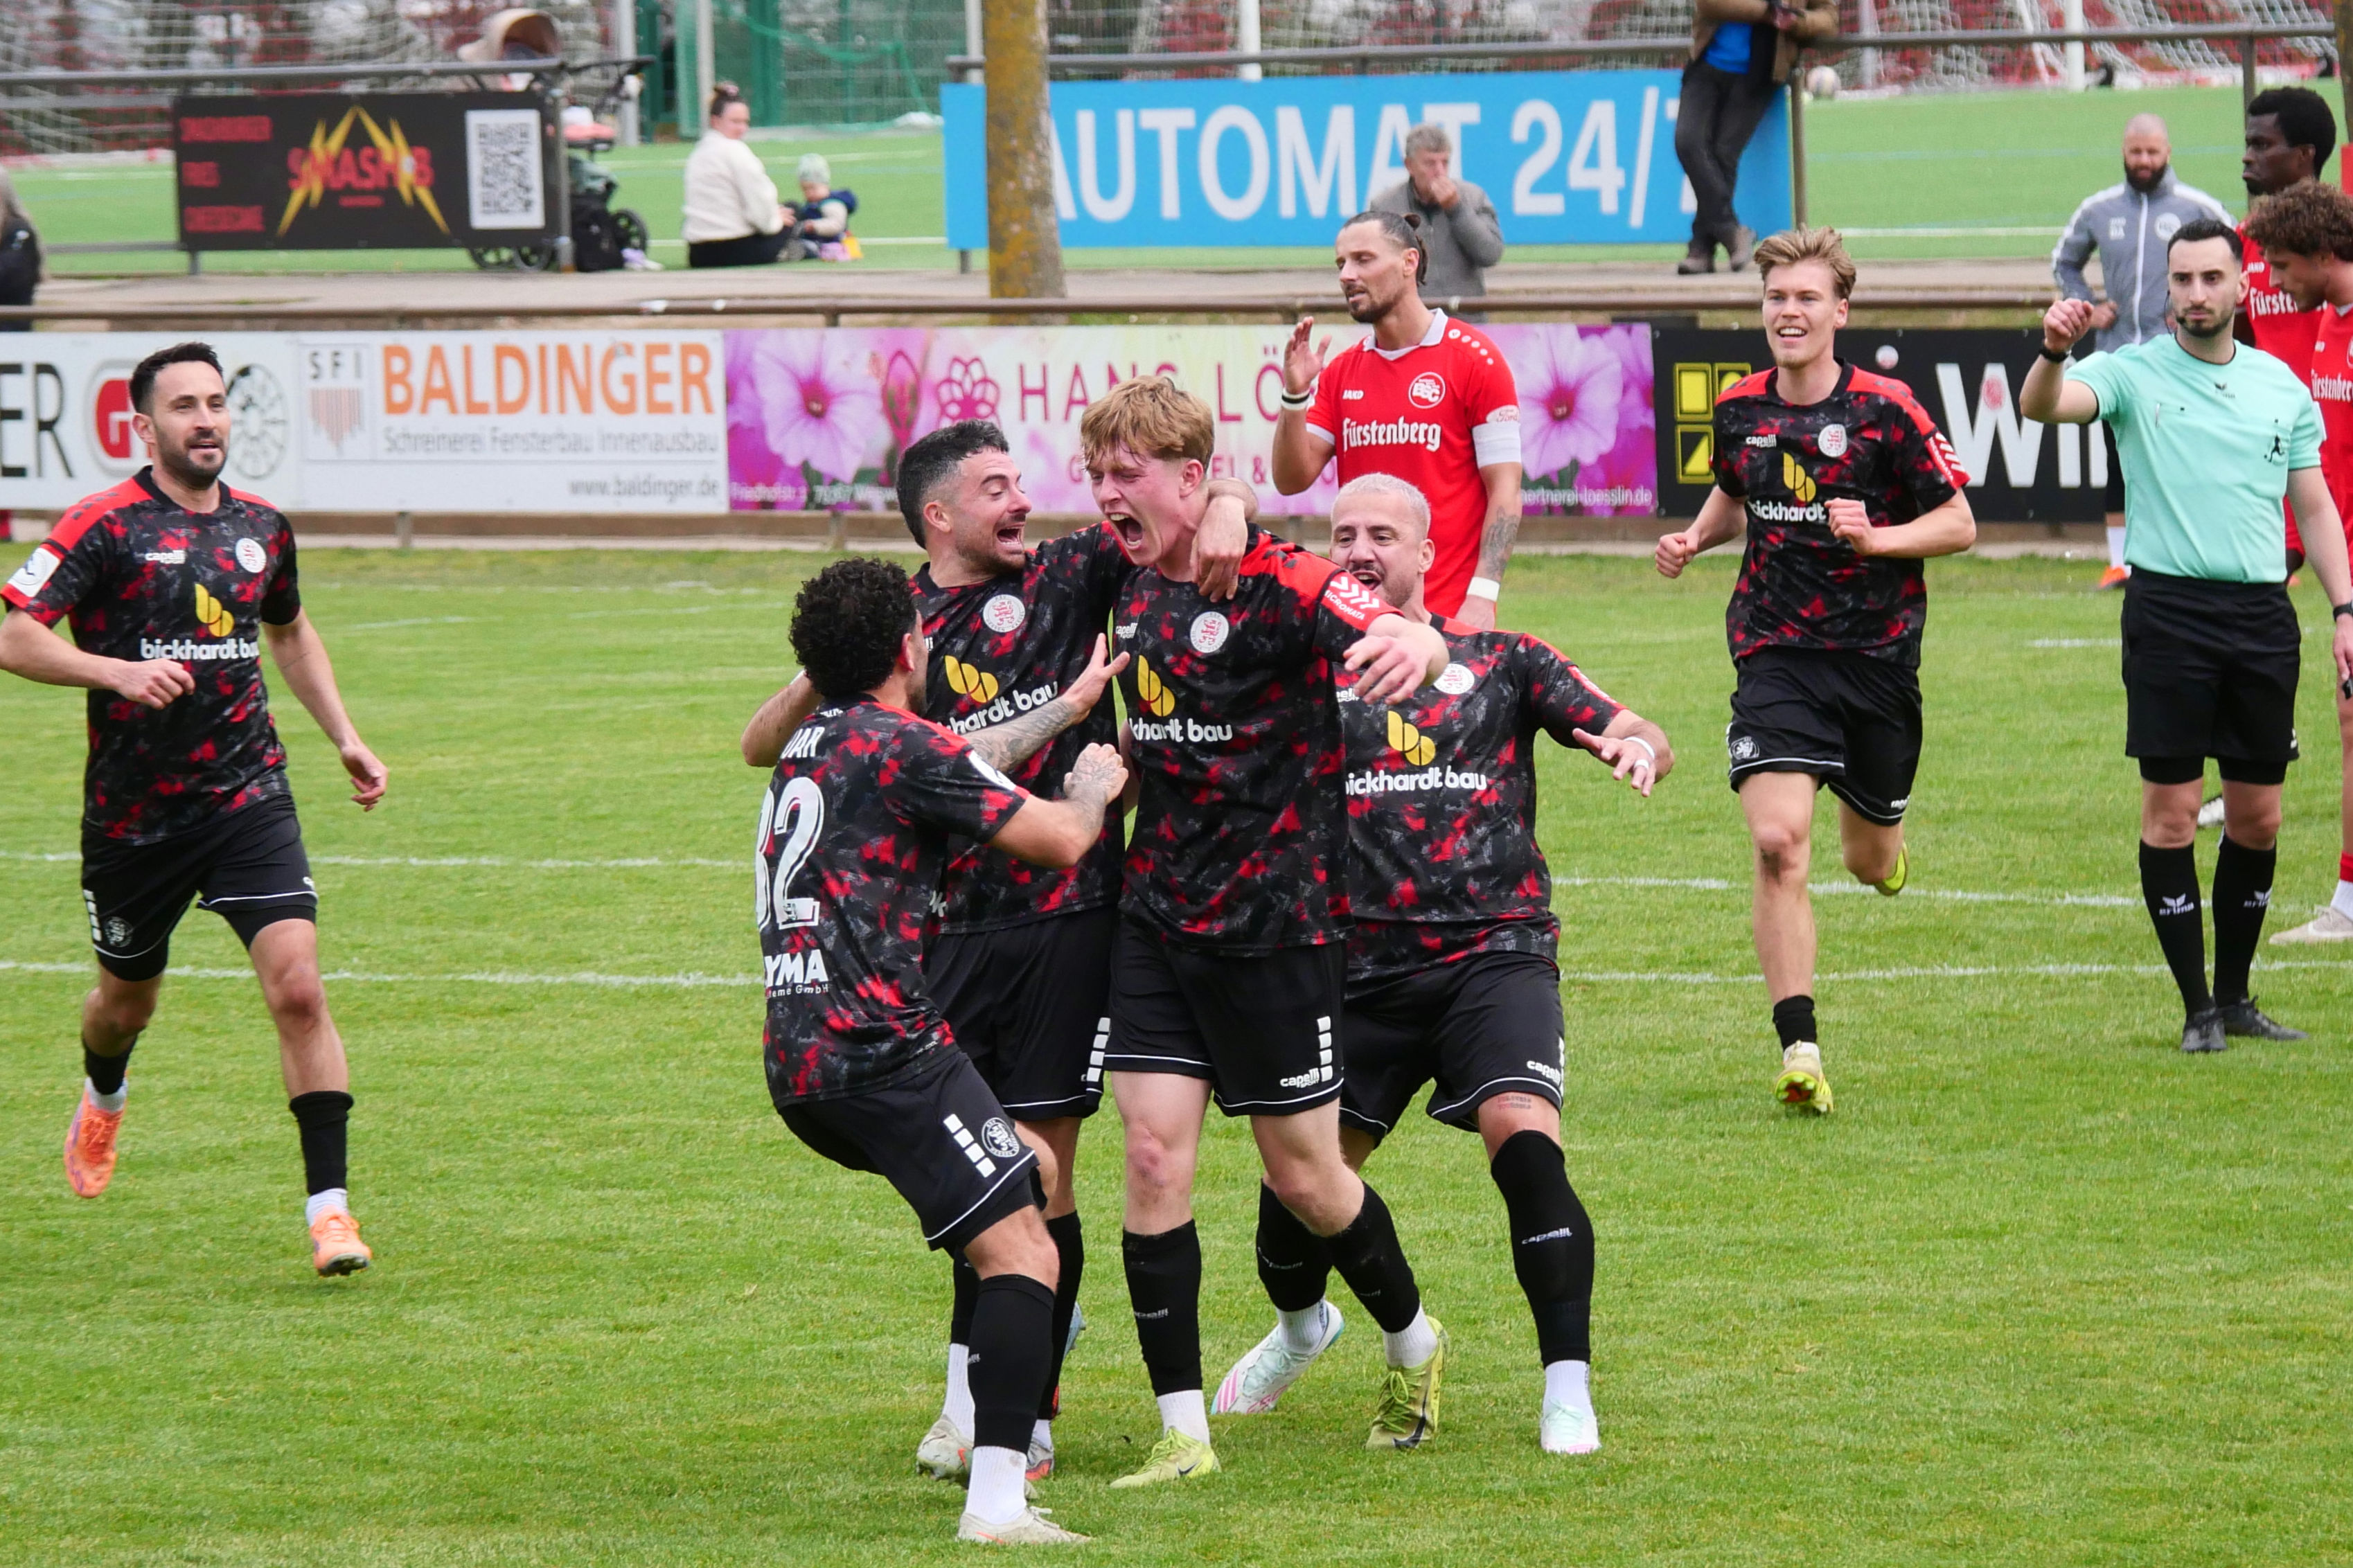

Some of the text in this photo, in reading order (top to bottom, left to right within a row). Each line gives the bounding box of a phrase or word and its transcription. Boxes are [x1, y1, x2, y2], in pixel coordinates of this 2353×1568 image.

[382, 341, 715, 416] BALDINGER
[140, 637, 239, 659] bickhardt
[1013, 681, 1058, 712] bau
[1187, 718, 1234, 742] bau
[1345, 765, 1488, 796] ickhardt bau
[795, 983, 829, 995] GmbH
[1279, 1067, 1320, 1088] capelli
